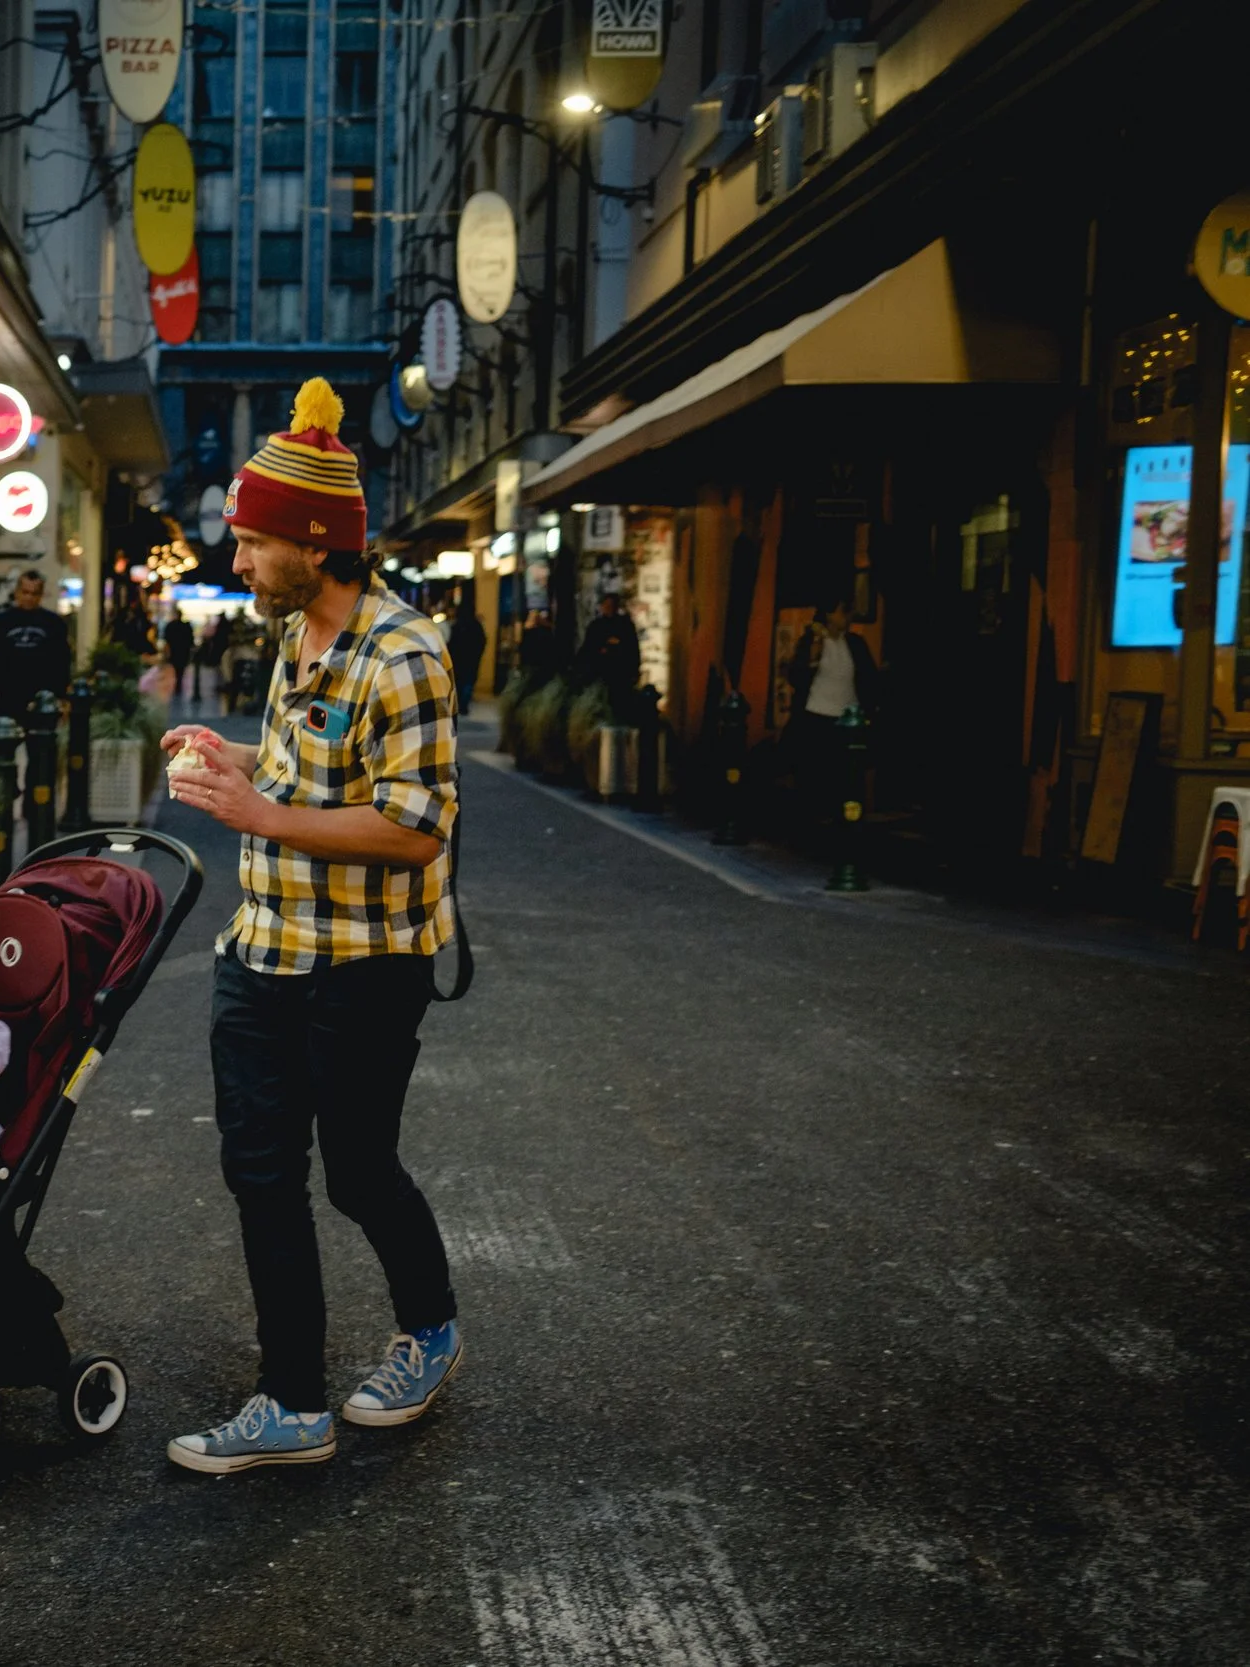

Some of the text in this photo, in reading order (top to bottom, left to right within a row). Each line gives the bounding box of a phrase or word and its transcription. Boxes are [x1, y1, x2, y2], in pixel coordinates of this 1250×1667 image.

[105, 37, 175, 55] PIZZA
[121, 60, 160, 73] BAR
[139, 187, 191, 204] YUZU
